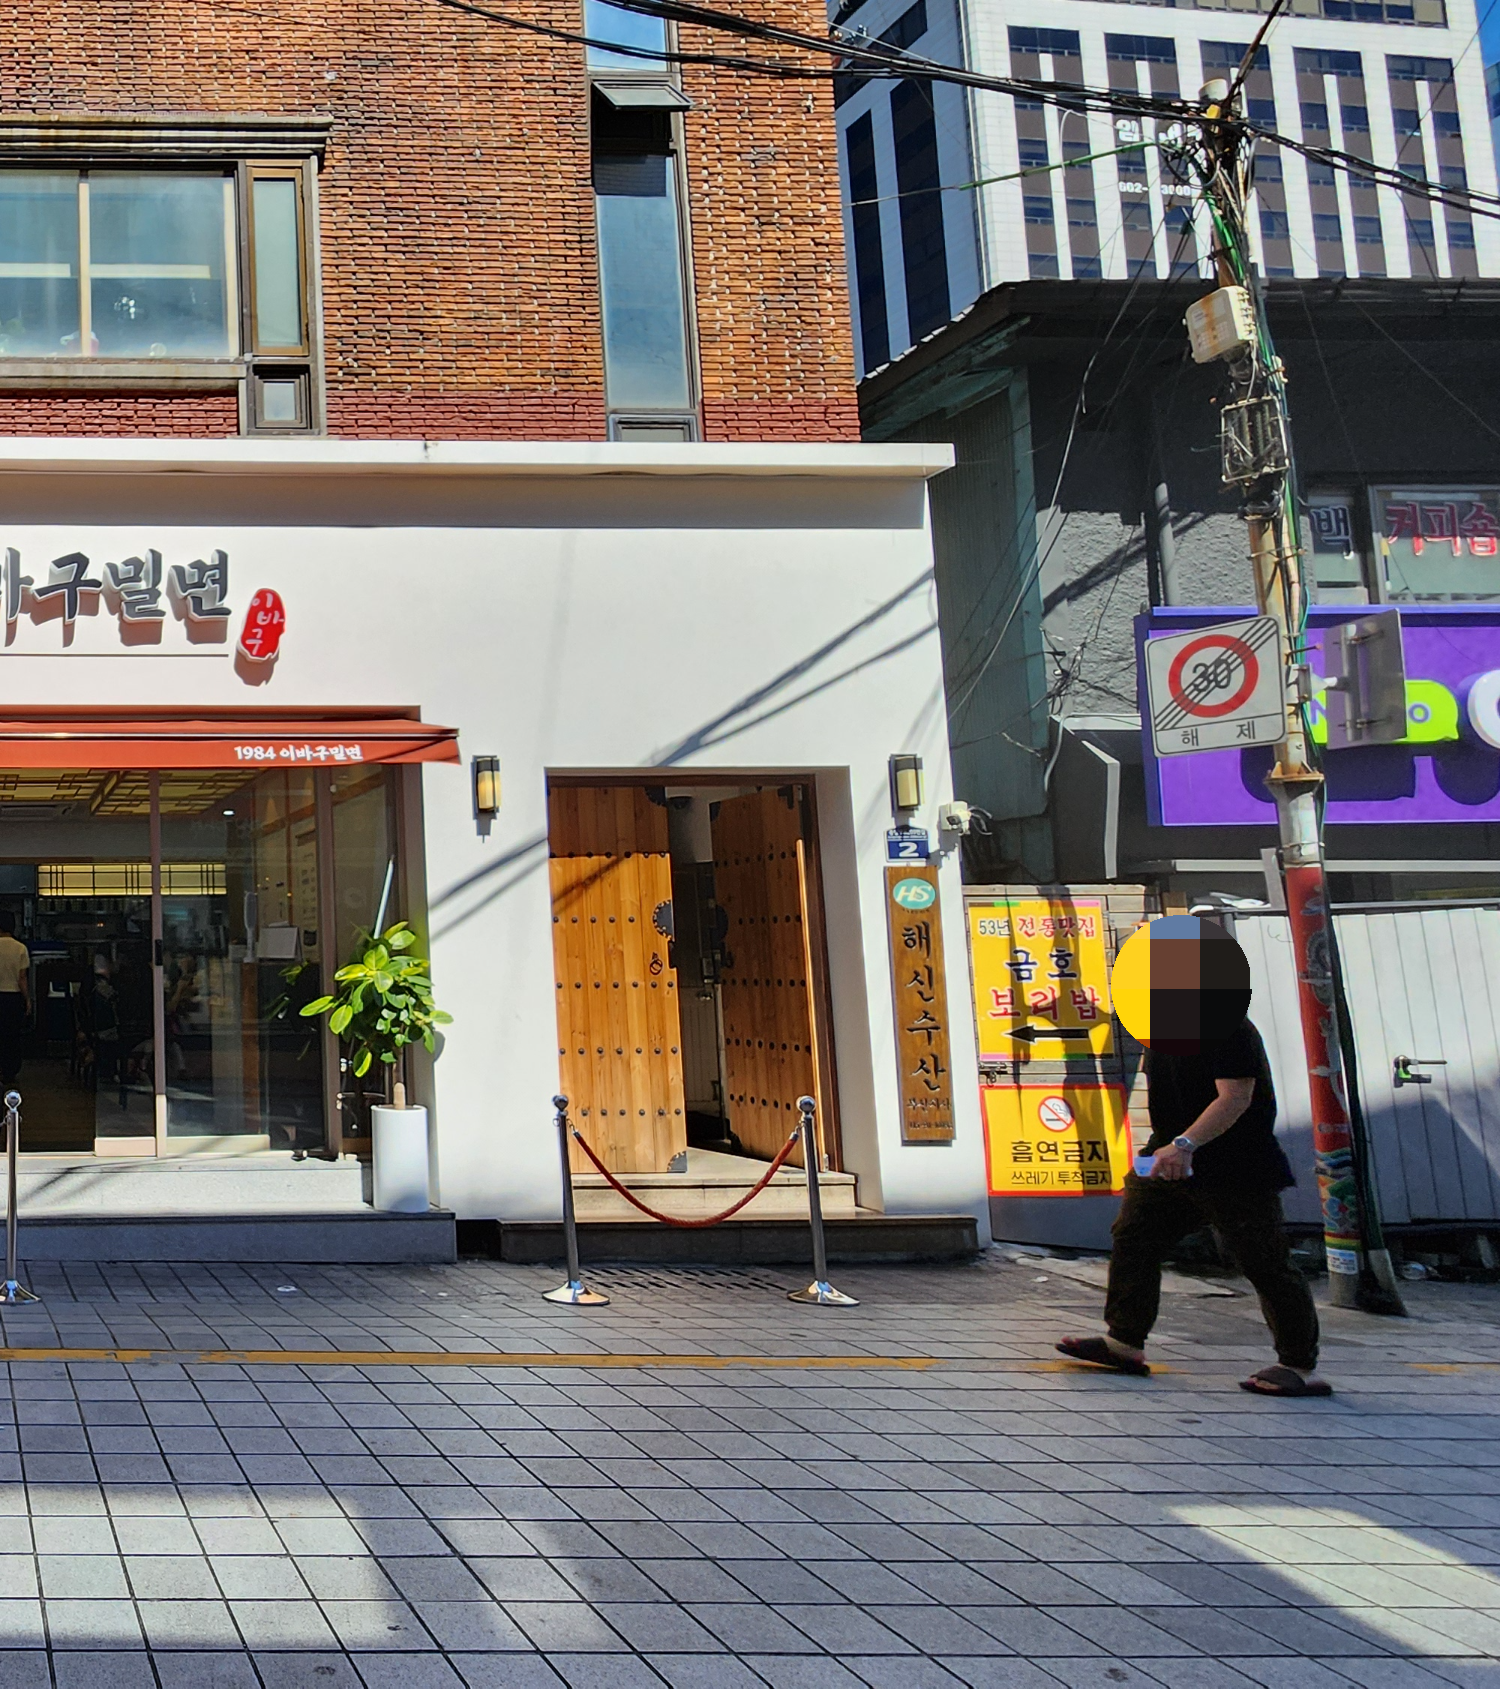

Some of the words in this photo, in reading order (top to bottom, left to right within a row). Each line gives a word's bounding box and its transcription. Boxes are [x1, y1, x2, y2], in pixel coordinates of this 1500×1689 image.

[1192, 658, 1232, 693] 30
[234, 745, 277, 761] 1984
[279, 744, 364, 762] 이바구밀면
[898, 841, 920, 858] 2
[896, 884, 933, 903] HS
[979, 918, 1011, 937] 53년
[1018, 916, 1095, 938] 전통맛집
[901, 920, 946, 1092] 해신수산
[989, 985, 1101, 1020] 보리밥
[1011, 1140, 1110, 1163] 흡연금지
[1011, 1170, 1055, 1185] 쓰레기
[1057, 1170, 1113, 1186] 투척금지
